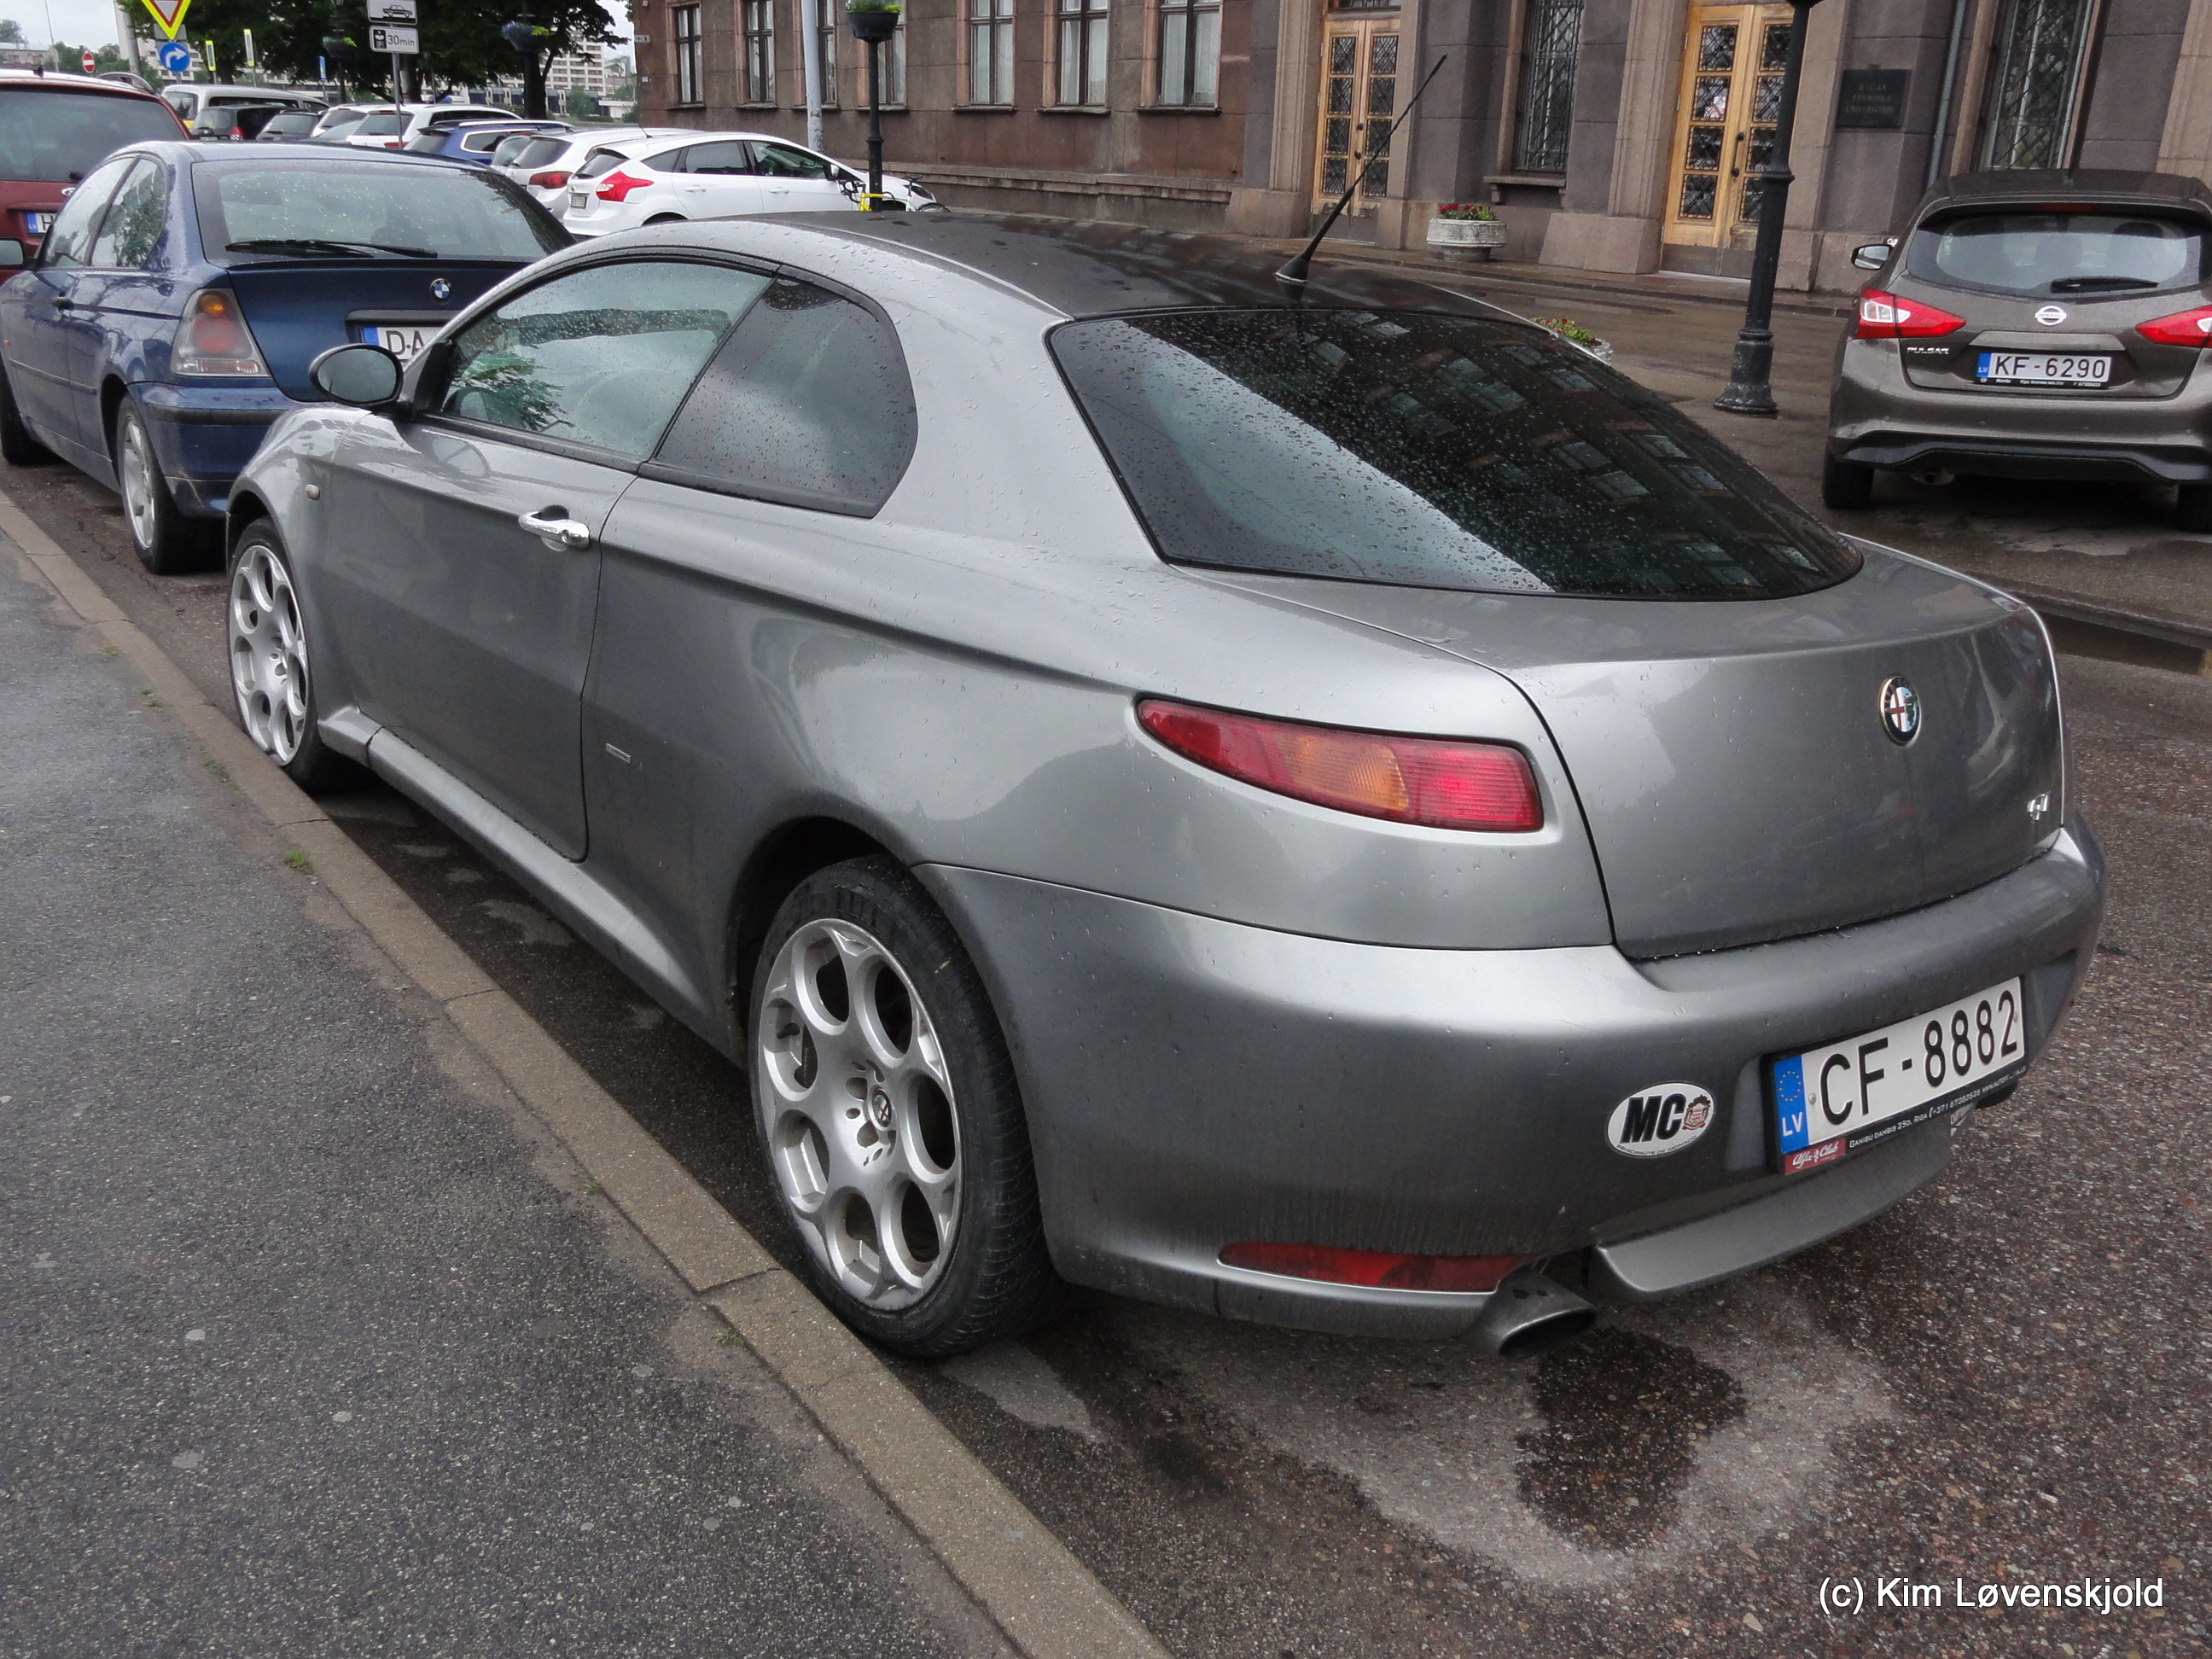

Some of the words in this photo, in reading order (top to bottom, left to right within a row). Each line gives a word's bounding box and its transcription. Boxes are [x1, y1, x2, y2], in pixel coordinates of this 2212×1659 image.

[1994, 356, 2106, 379] KF-6290
[1820, 990, 2017, 1126] CF-8882
[1620, 1093, 1686, 1144] MC
[1782, 1112, 1802, 1137] LV
